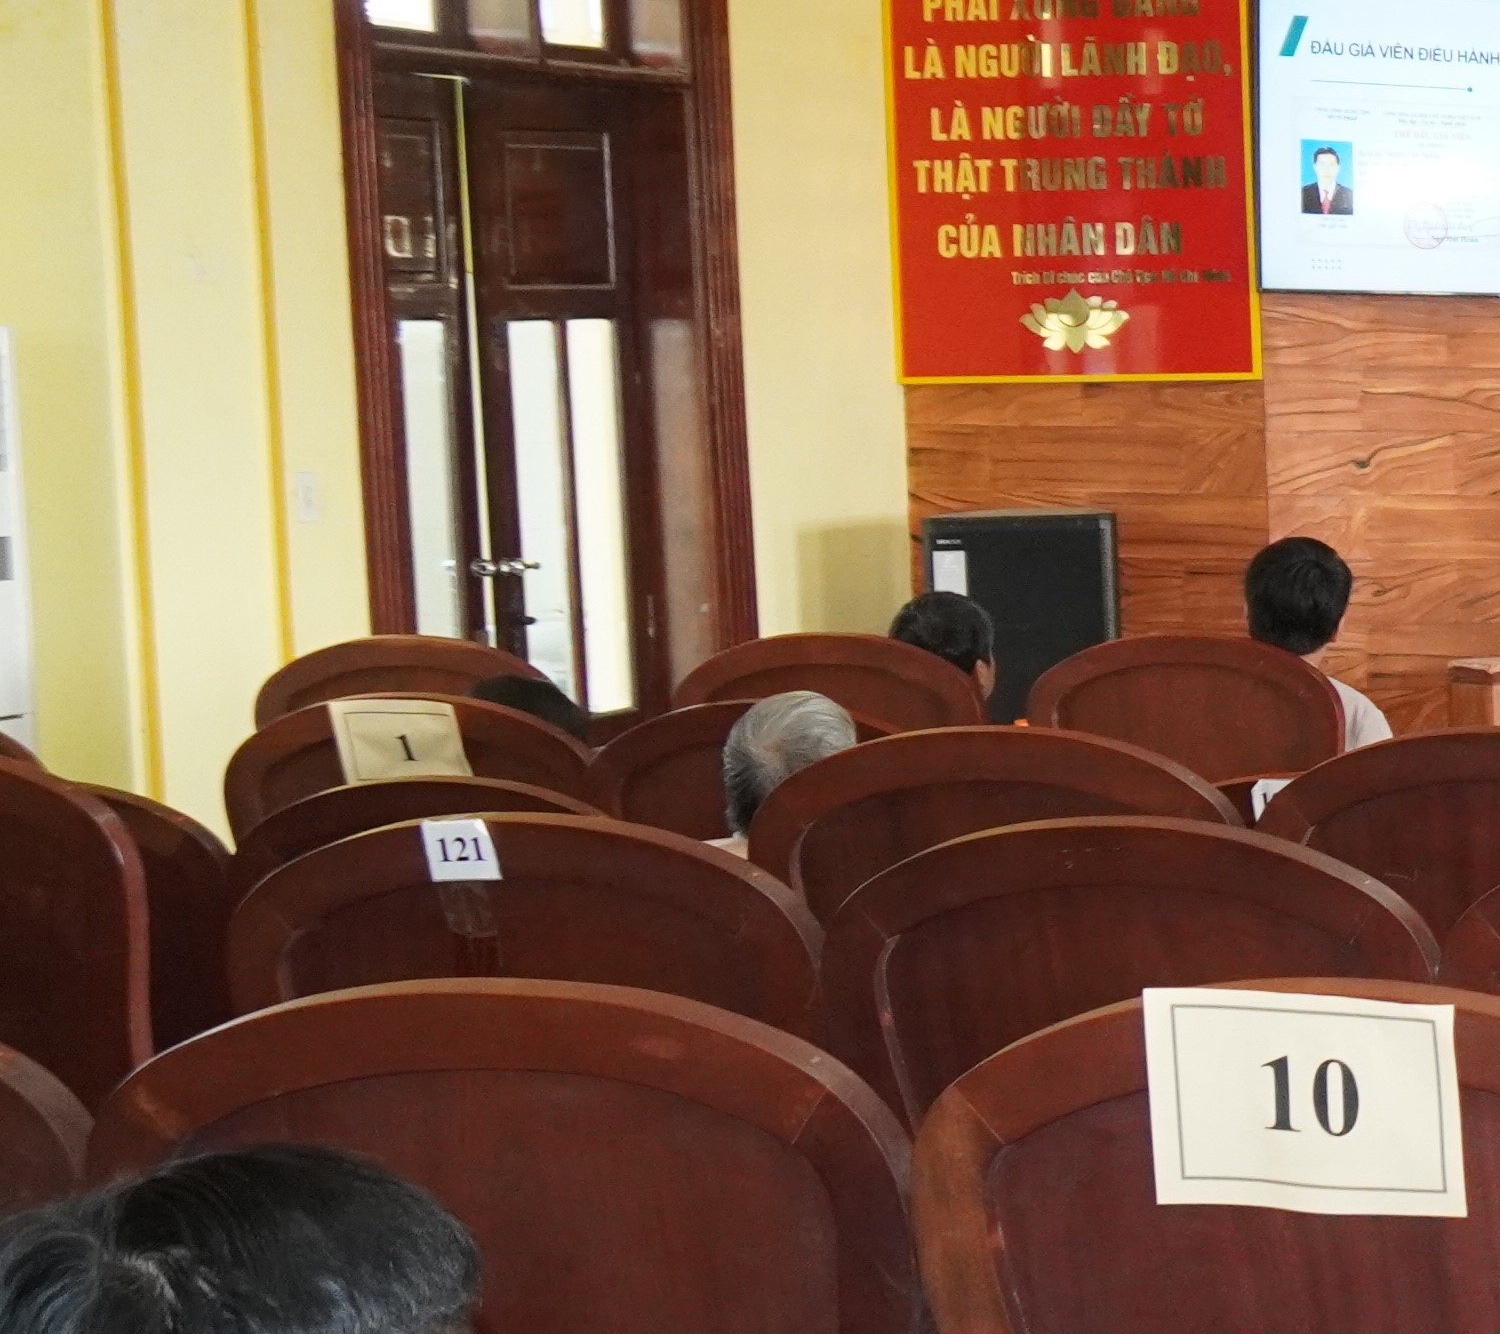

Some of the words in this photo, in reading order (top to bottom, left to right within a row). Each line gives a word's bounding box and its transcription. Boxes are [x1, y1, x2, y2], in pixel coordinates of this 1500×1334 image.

[904, 38, 945, 80] LÀ
[954, 34, 1053, 79] NGƯỜI
[1061, 36, 1147, 77] LÃNH
[1157, 38, 1232, 82] ĐẠO,
[930, 100, 971, 142] LÀ
[981, 95, 1081, 140] NGƯỜI
[1165, 95, 1204, 137] TỚ
[913, 153, 993, 200] THẬT
[1001, 156, 1108, 193] TRUNG
[1118, 149, 1227, 190] THÀNH
[937, 213, 1002, 259] CỦA
[1012, 216, 1105, 257] NHÂN
[1115, 215, 1182, 256] DÂN
[395, 734, 419, 762] 1
[437, 836, 488, 863] 121
[1260, 1054, 1360, 1138] 10
